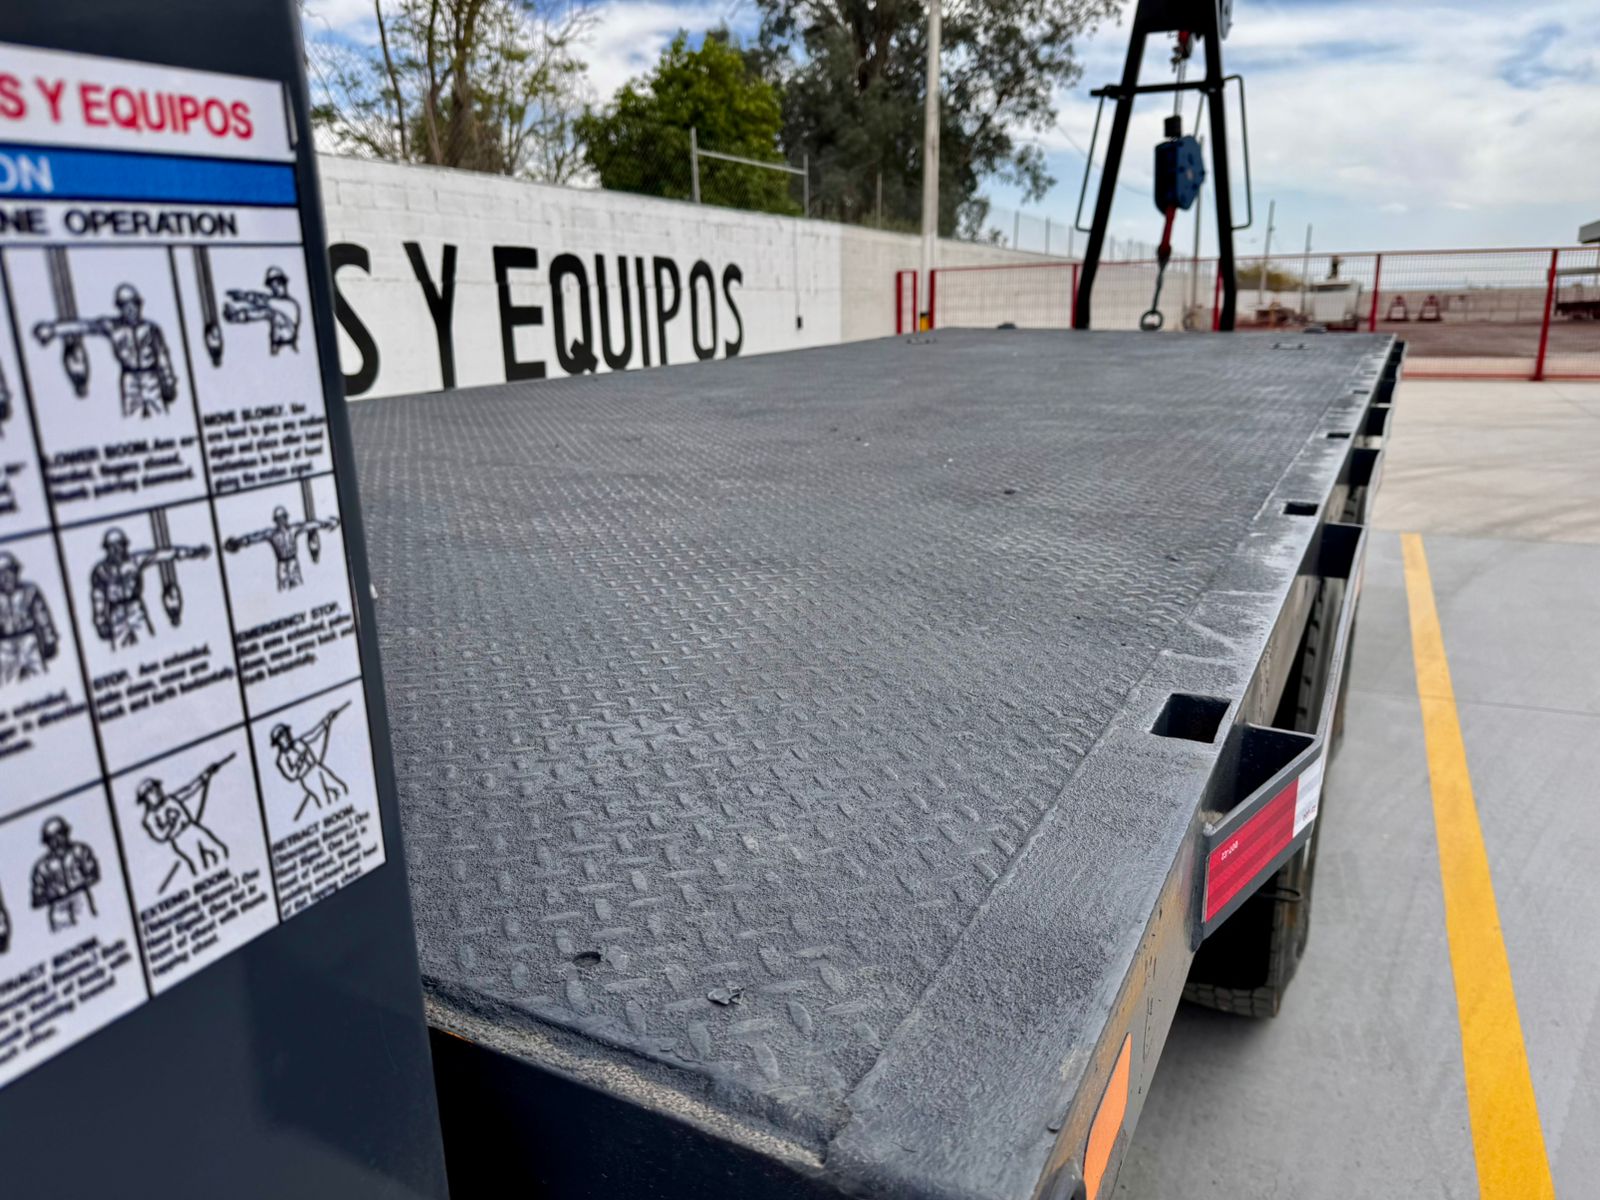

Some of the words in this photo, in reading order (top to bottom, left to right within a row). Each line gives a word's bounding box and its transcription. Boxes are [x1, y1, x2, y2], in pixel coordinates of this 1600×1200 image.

[0, 71, 26, 120] S
[35, 76, 65, 124] Y
[79, 82, 254, 140] EQUIPOS
[64, 209, 238, 237] OPERATION
[328, 242, 379, 397] S
[403, 241, 458, 391] Y
[492, 245, 744, 384] EQUIPOS
